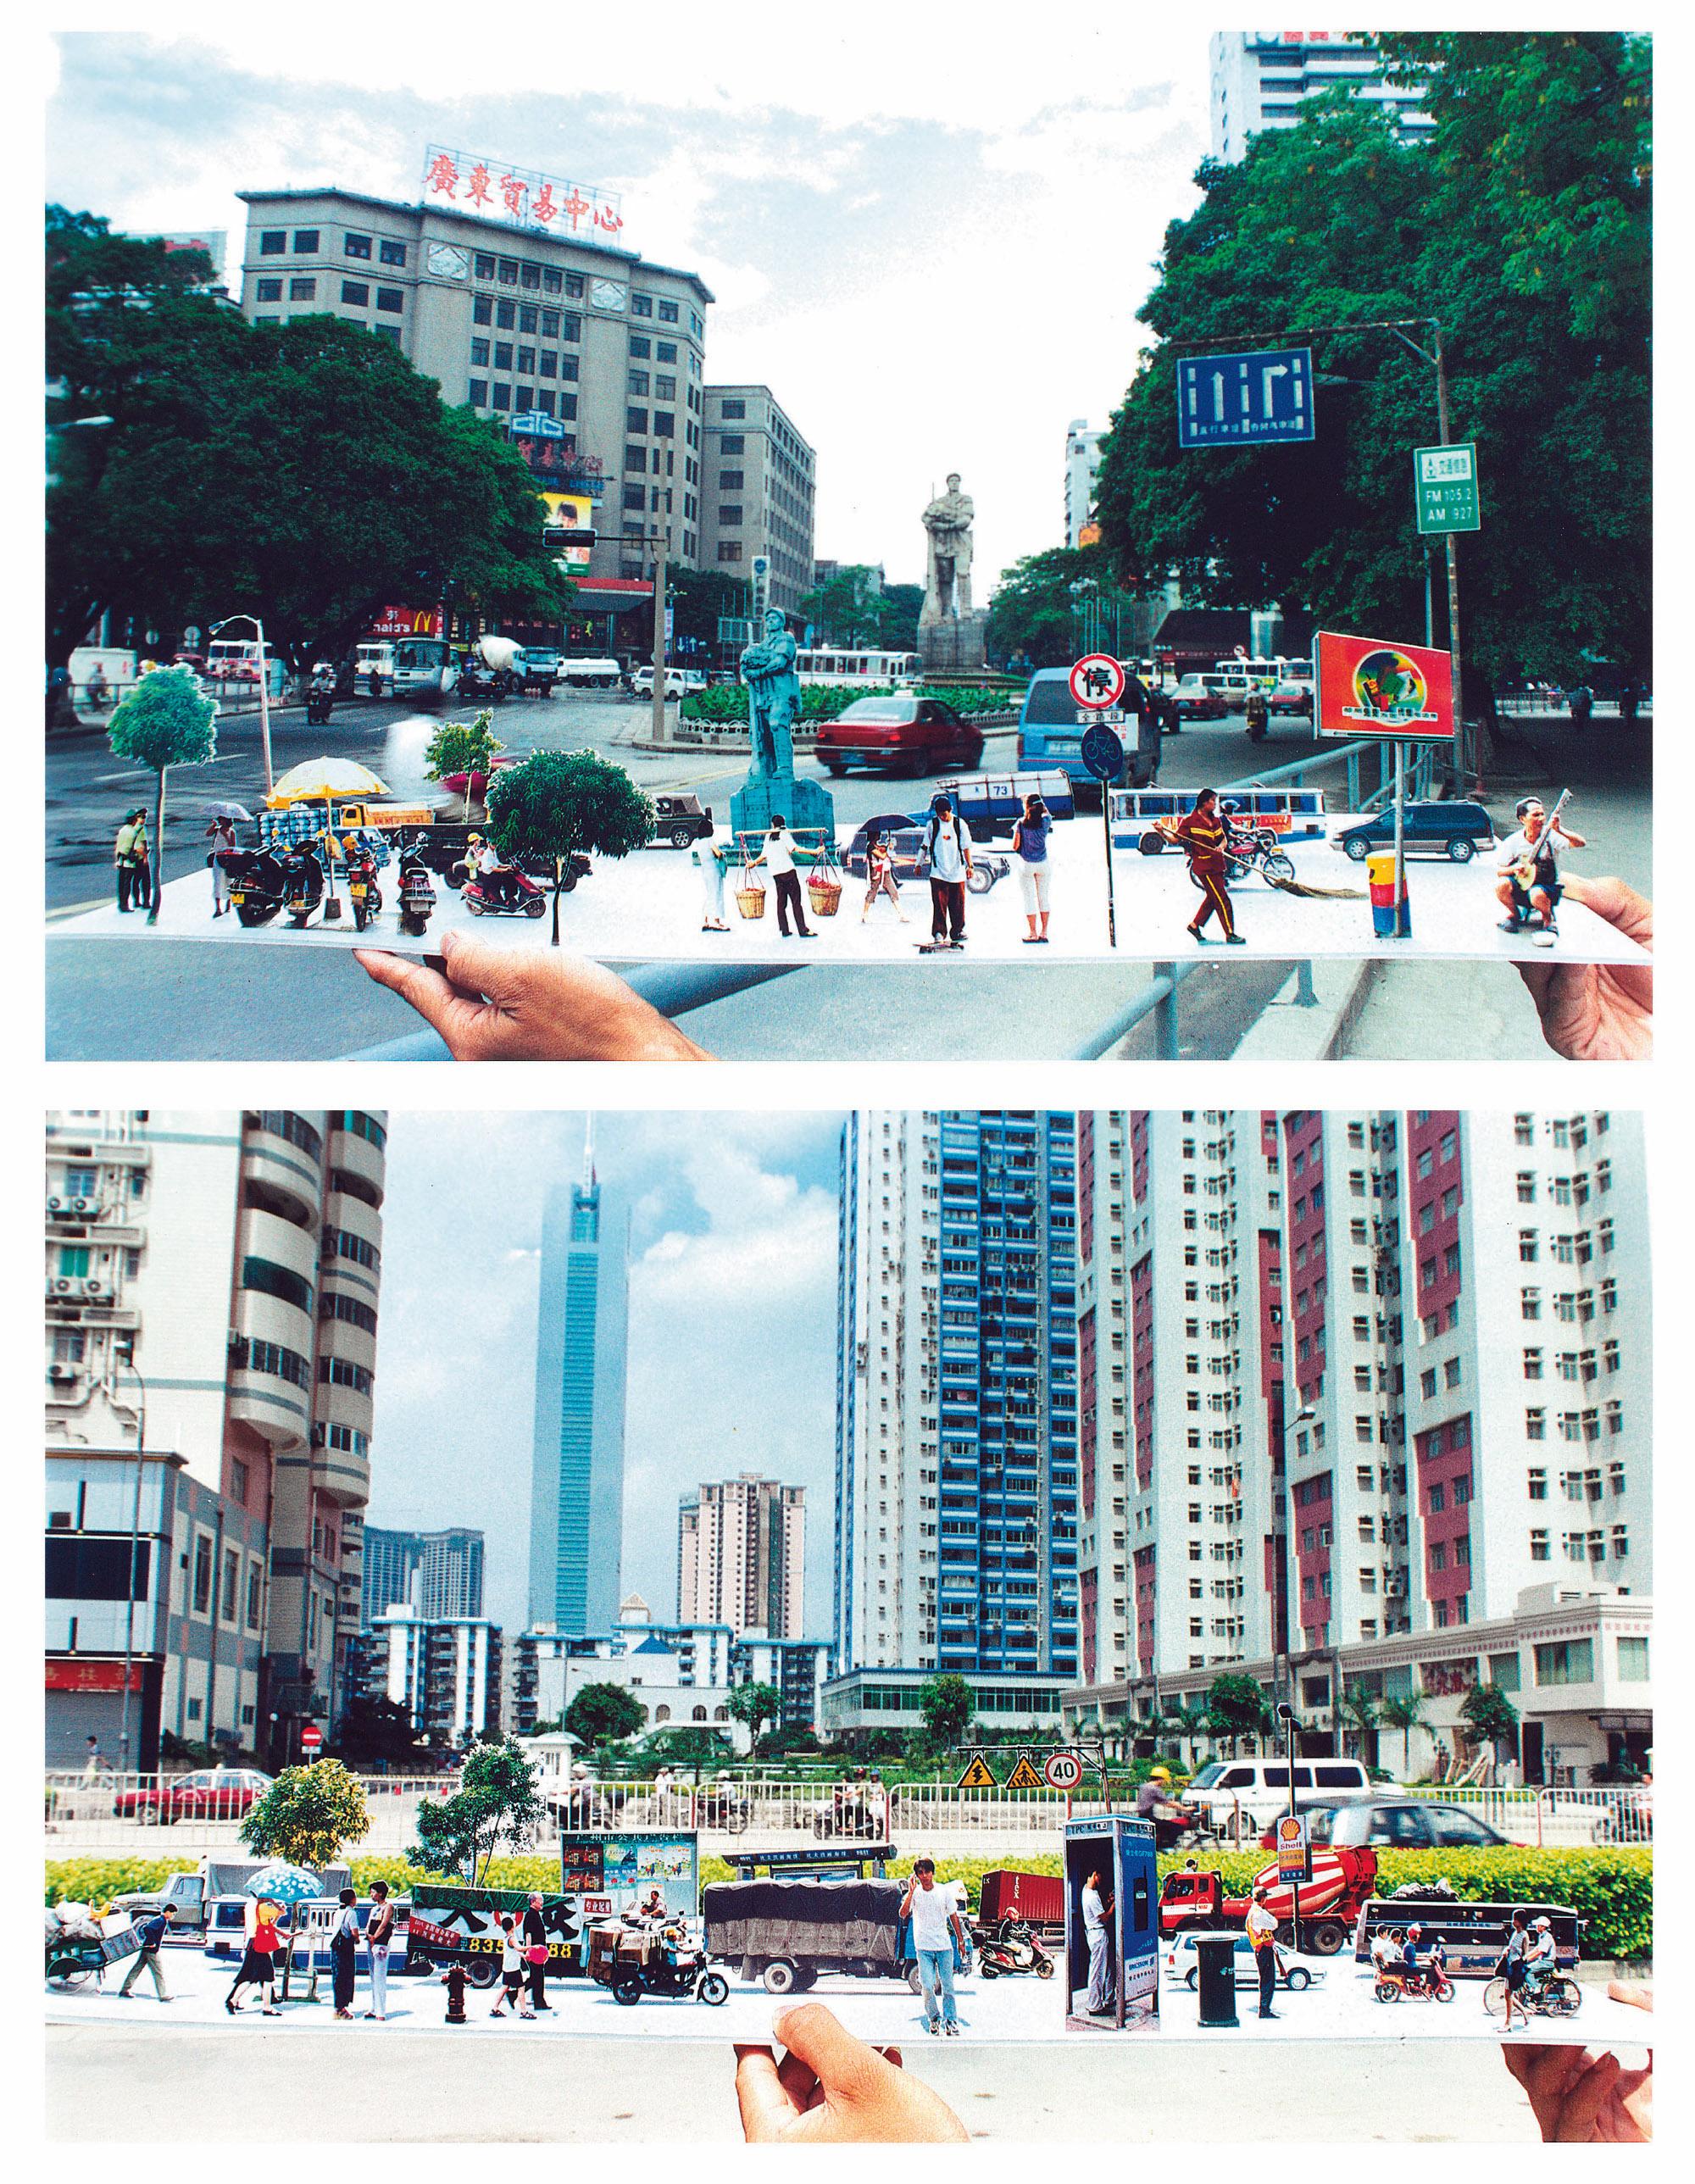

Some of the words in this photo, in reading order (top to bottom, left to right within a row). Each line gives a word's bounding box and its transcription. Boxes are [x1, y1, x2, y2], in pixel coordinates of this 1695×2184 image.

[421, 154, 624, 232] 廣東貿易中心
[1426, 489, 1442, 503] FM
[1428, 508, 1446, 521] AM
[1453, 506, 1472, 520] 927
[1081, 667, 1113, 697] 停
[992, 786, 1008, 796] 73
[1053, 1761, 1075, 1779] 40
[1281, 1841, 1303, 1850] Shell
